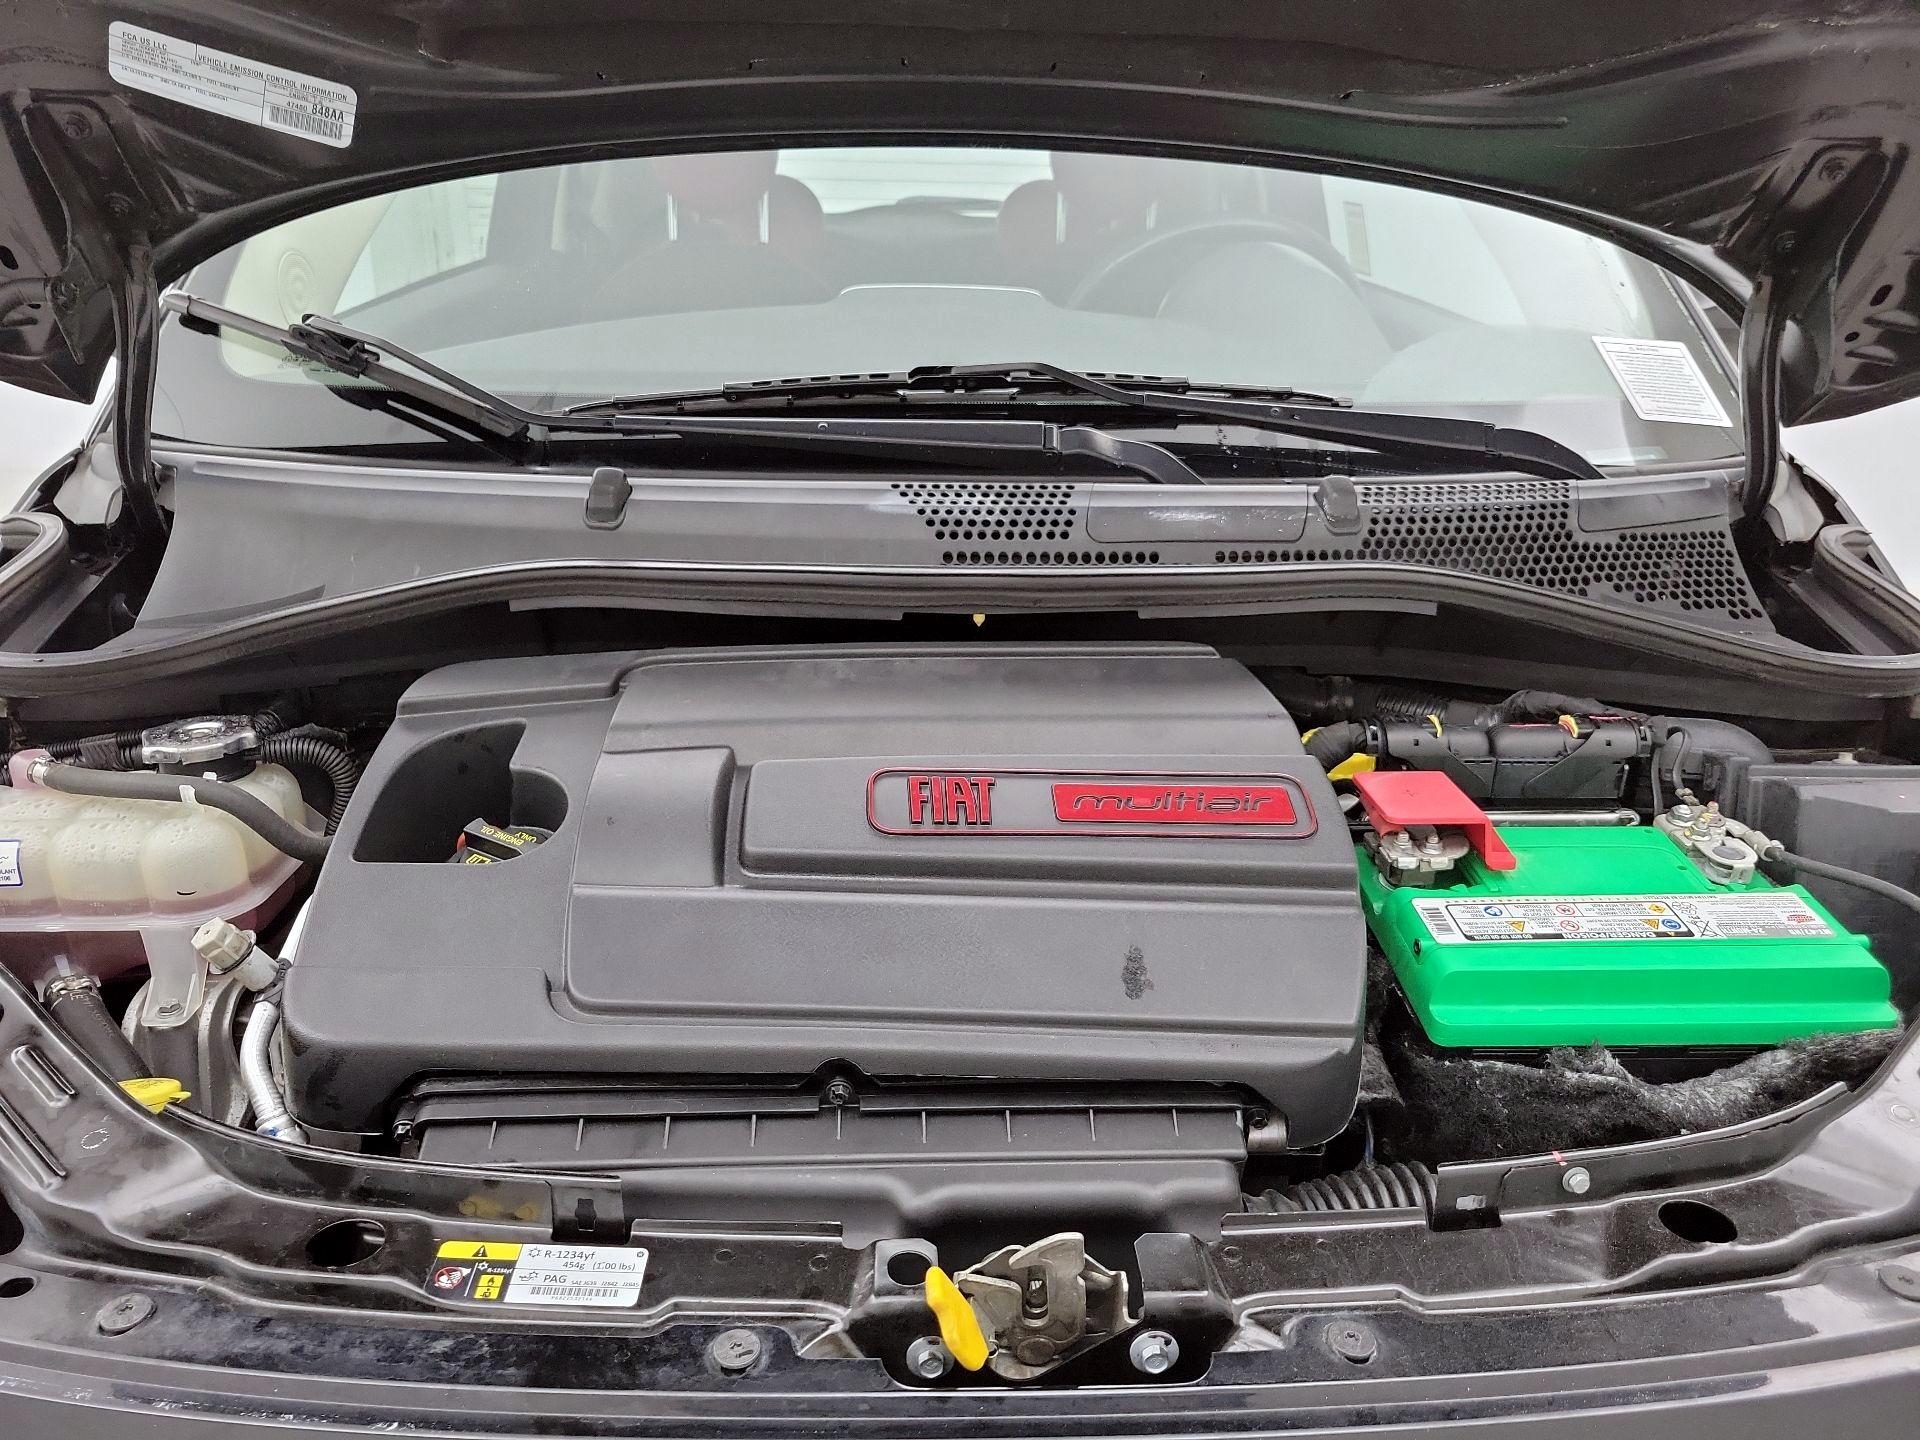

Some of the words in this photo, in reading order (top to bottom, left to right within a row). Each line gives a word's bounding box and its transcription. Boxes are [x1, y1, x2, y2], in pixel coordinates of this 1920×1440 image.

[122, 32, 138, 42] FCA
[140, 37, 151, 46] US
[153, 41, 168, 51] LLC
[197, 54, 228, 69] VEHICLE
[230, 64, 264, 80] EMISSION
[266, 74, 298, 89] CONTROL
[300, 82, 348, 102] INFORMATION
[312, 104, 344, 122] 848AA
[907, 775, 995, 826] FIAT
[1073, 790, 1273, 815] multiair
[480, 825, 495, 835] OIL
[514, 831, 537, 843] ONLY
[493, 830, 525, 846] ENGINE
[544, 1250, 595, 1261] R-1234yf
[562, 1261, 586, 1270] 454g
[618, 1262, 636, 1271] lbs)
[543, 1275, 567, 1284] PAG
